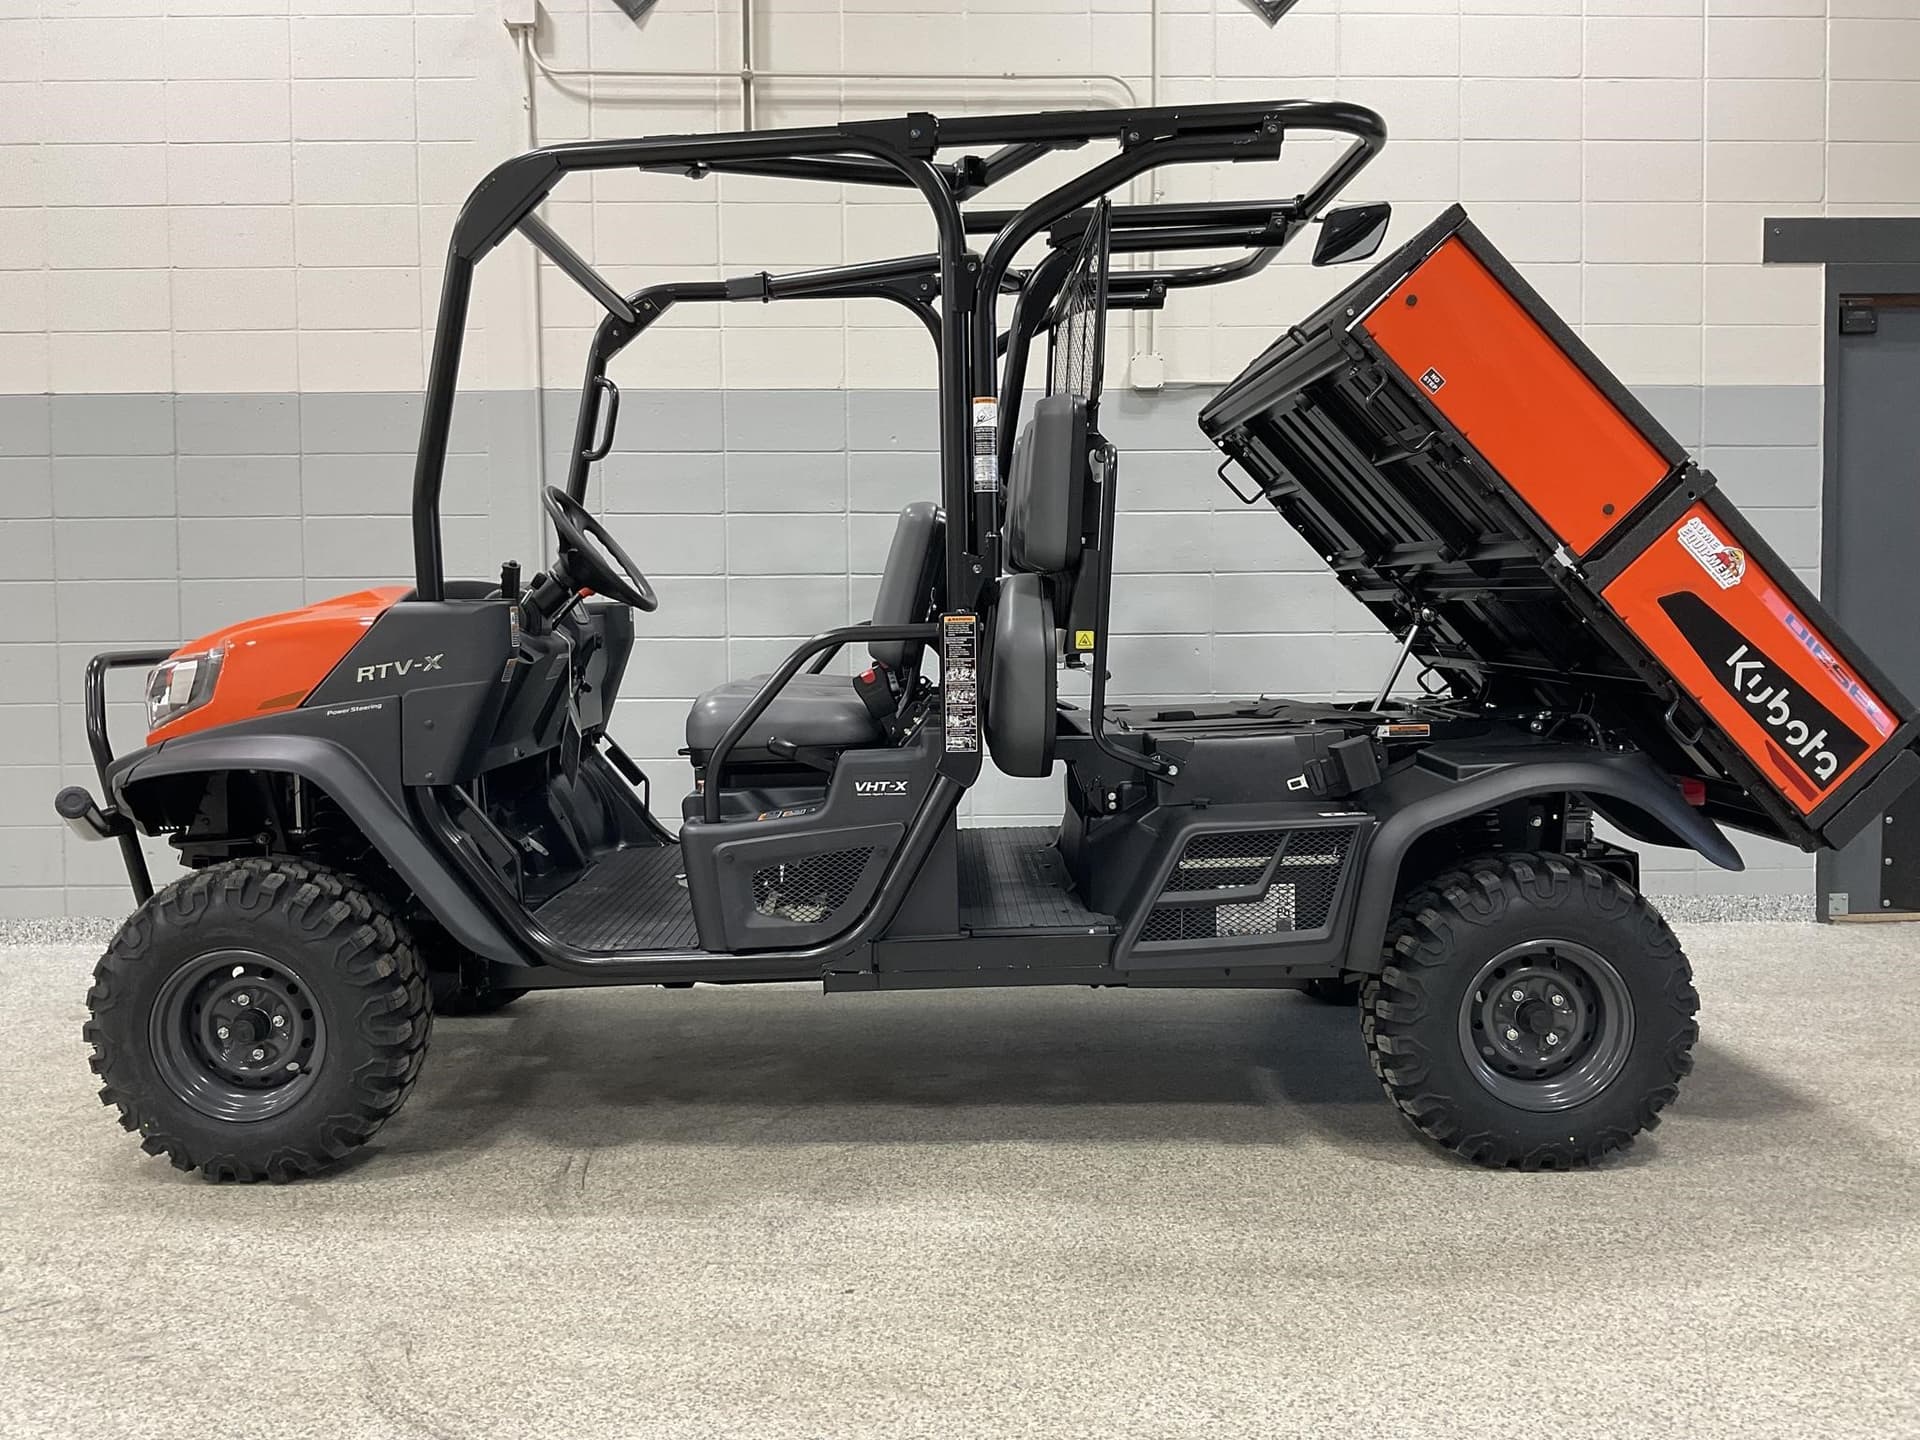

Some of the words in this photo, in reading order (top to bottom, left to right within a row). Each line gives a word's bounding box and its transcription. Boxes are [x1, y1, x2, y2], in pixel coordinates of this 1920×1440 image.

[1423, 375, 1438, 390] STEP
[1430, 373, 1441, 383] NO
[1689, 520, 1721, 551] ACME
[1680, 527, 1739, 586] EQUIPMENT
[356, 653, 445, 683] RTV-X
[1785, 613, 1886, 730] DIESEL
[326, 706, 350, 717] Power
[350, 703, 383, 713] Steering
[1726, 644, 1838, 781] Kubota
[855, 781, 909, 792] VHT-X
